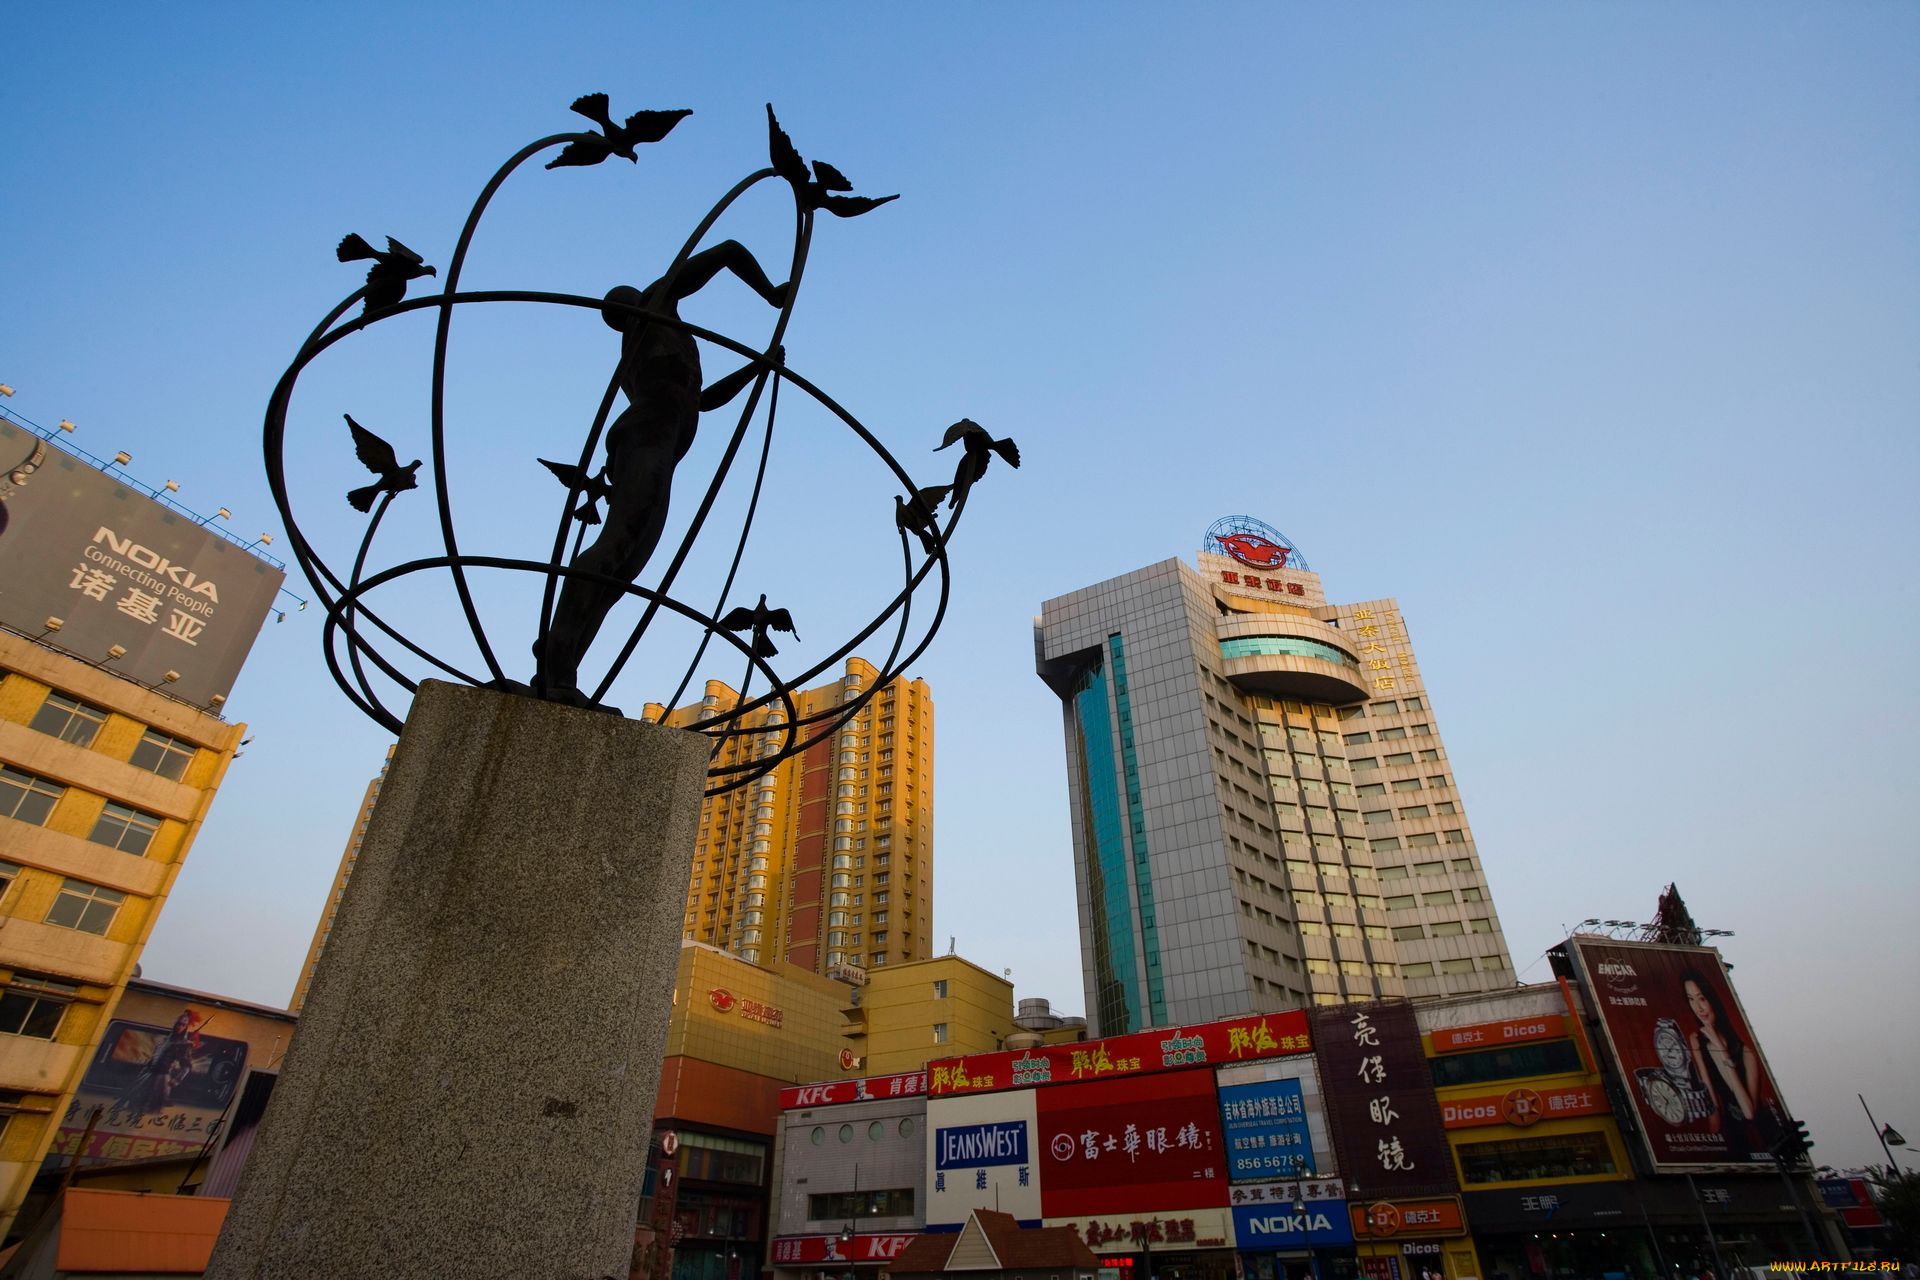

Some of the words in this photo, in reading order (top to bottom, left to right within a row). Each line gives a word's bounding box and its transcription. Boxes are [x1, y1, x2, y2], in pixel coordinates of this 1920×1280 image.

[92, 527, 219, 603] NOKIA
[84, 545, 166, 596] Connecting
[167, 586, 214, 618] People
[69, 563, 207, 646] 诺基亚
[1597, 963, 1638, 976] ENICAR
[1503, 1022, 1546, 1038] Dicos
[796, 1085, 836, 1105] KFC
[1224, 1094, 1301, 1120] 吉林省海外旅游总公司
[1444, 1103, 1497, 1122] Dicos
[1237, 1157, 1261, 1169] 856
[1249, 1213, 1333, 1234] NOKIA
[1402, 1243, 1440, 1255] Dicos
